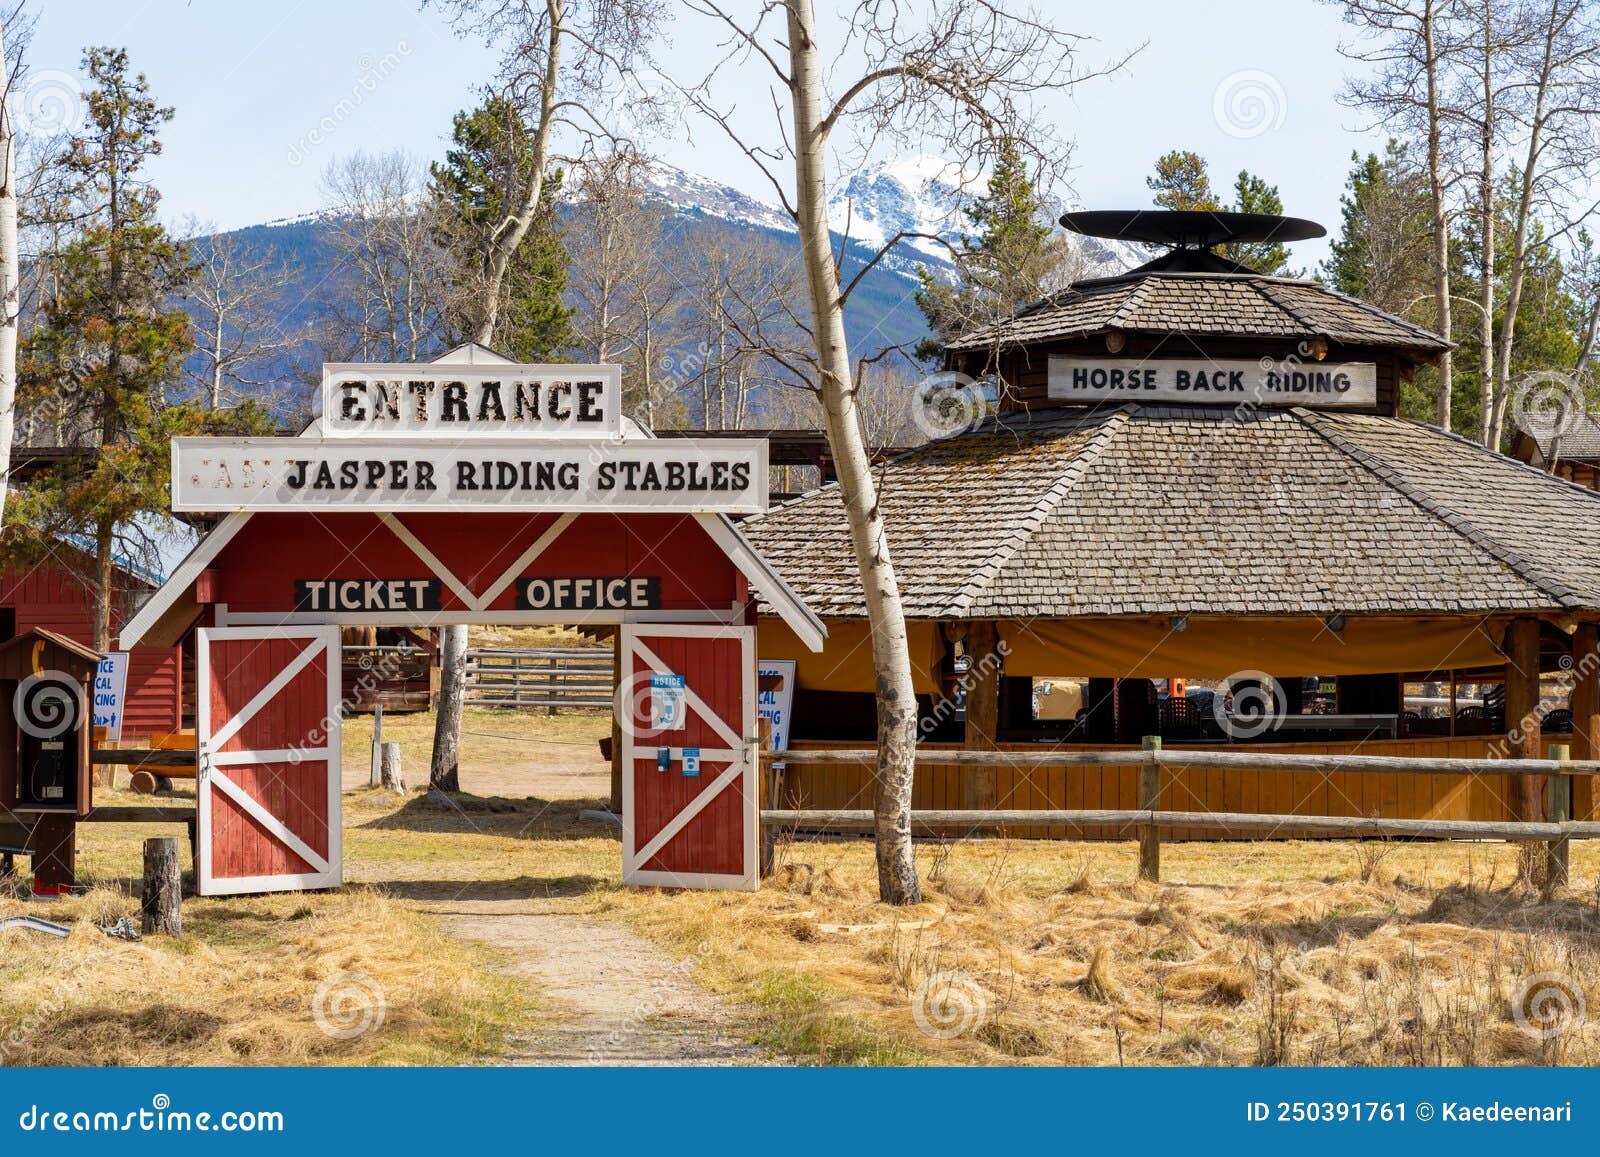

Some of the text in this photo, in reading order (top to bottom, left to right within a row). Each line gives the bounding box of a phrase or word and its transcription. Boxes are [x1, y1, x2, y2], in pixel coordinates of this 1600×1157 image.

[1073, 368, 1351, 393] HORSE BACK RIDING
[339, 380, 604, 422] ENTRANCE
[286, 460, 436, 490] JASPER
[456, 461, 580, 491] RIDING
[597, 461, 751, 491] STABLES
[305, 578, 649, 610] TICKET OFFICE
[654, 677, 681, 686] NOTICE
